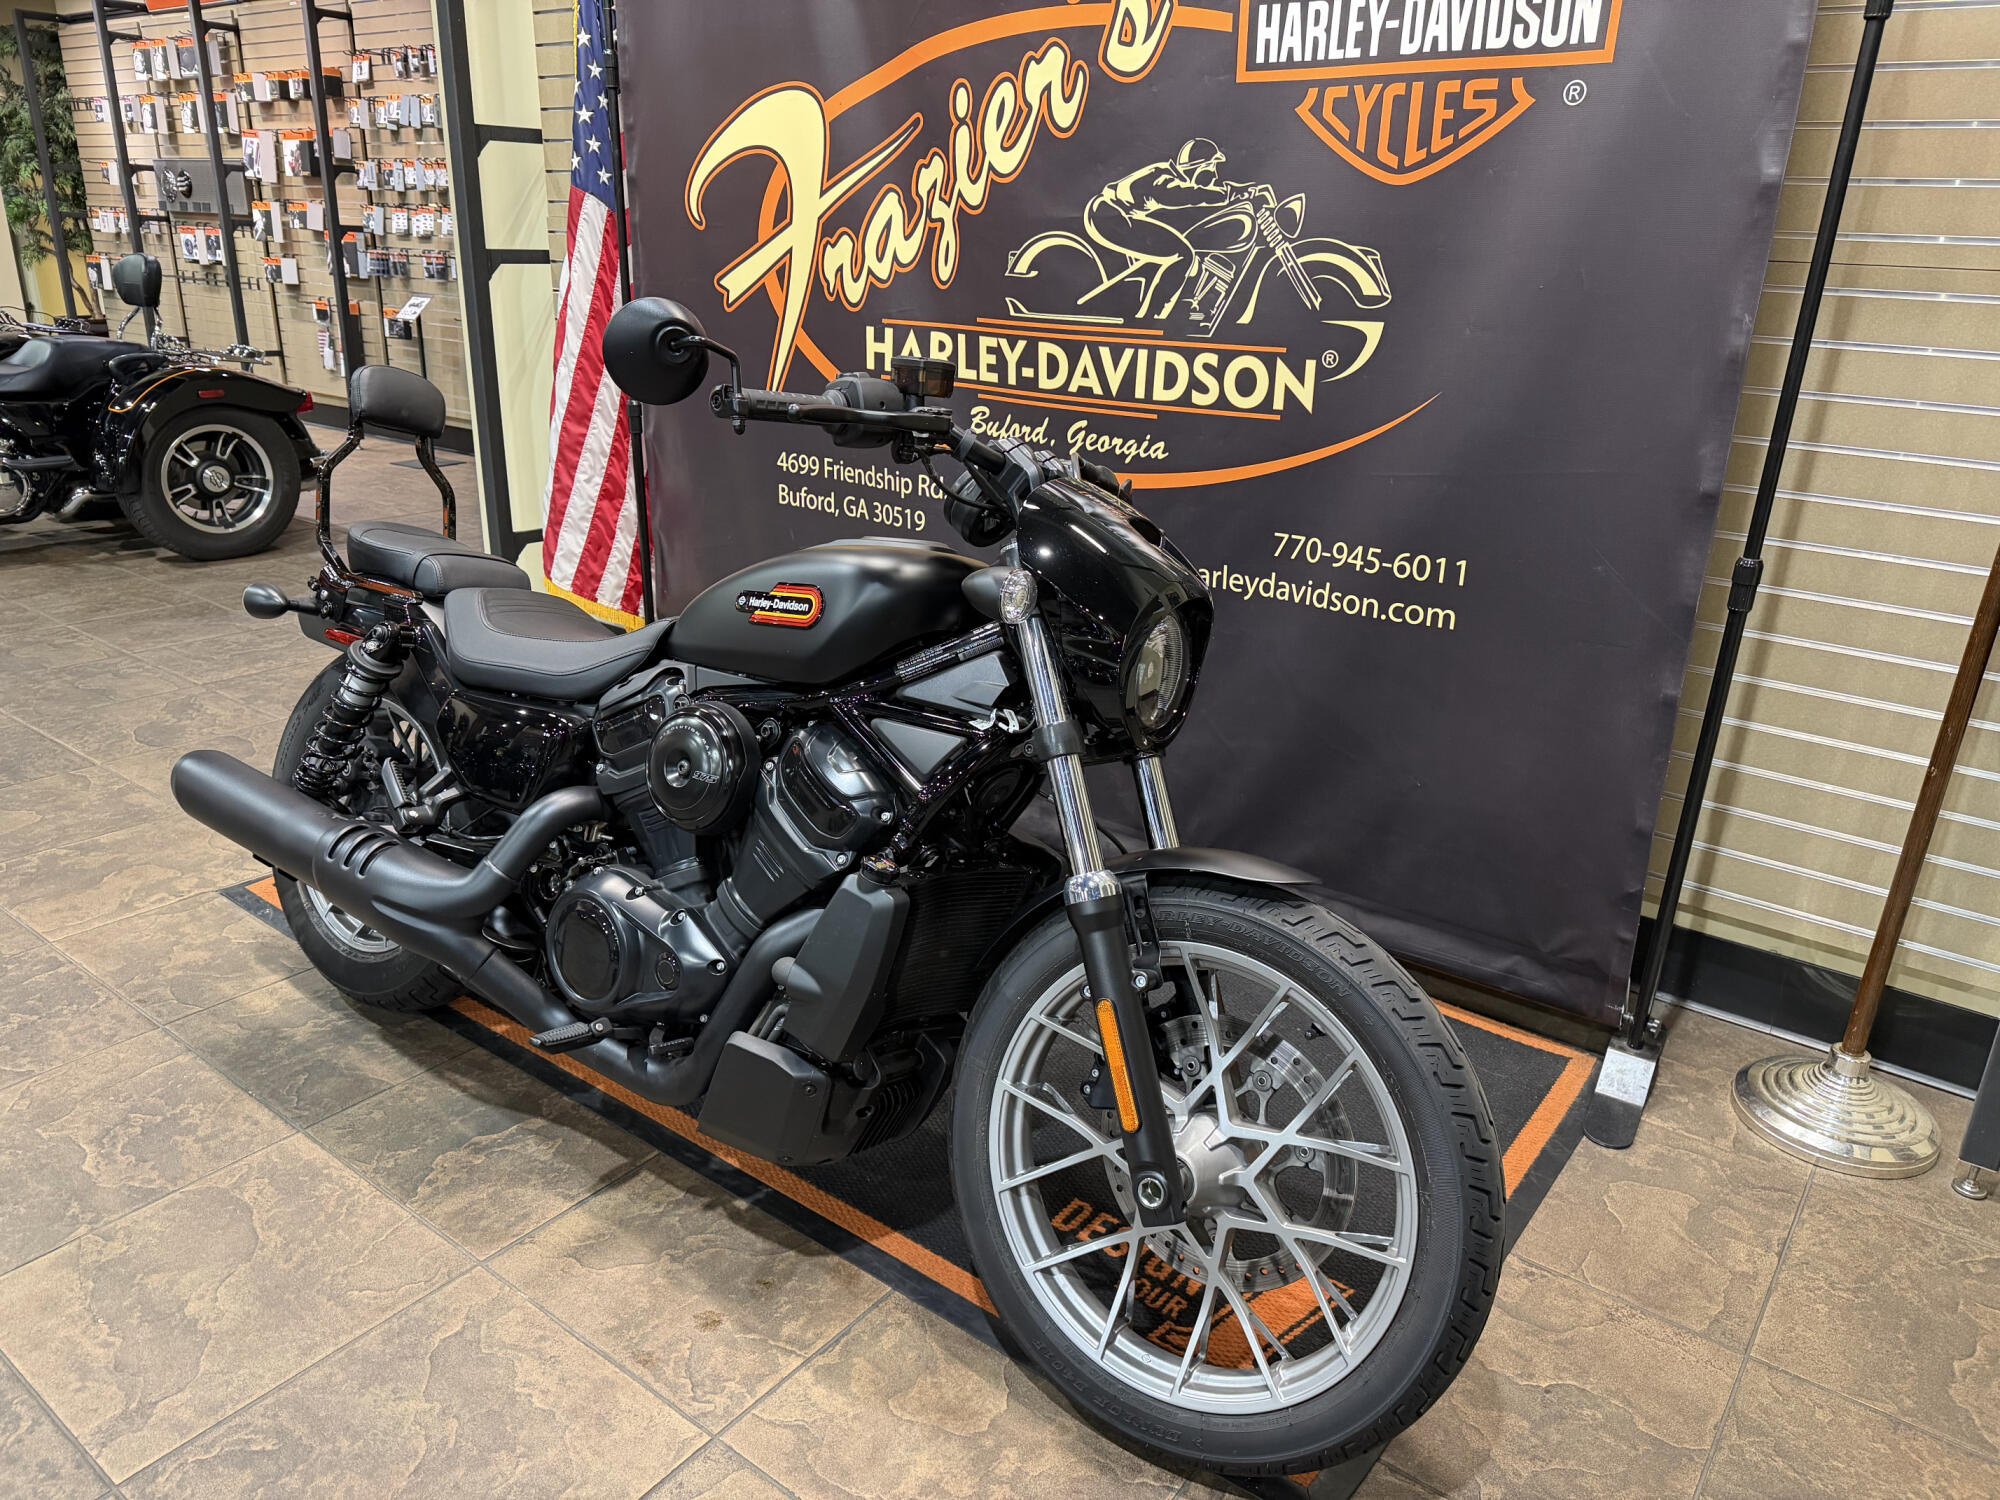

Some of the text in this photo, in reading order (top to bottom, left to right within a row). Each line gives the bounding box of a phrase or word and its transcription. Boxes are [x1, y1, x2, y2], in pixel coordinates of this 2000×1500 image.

[1255, 0, 1603, 63] HARLEY-DAVIDSON
[1322, 78, 1499, 169] CYCLES
[970, 405, 1169, 463] Buford, Georgia
[776, 451, 820, 477] 4699
[823, 457, 913, 499] Friendship
[777, 484, 926, 532] Buford, GA 30519
[1273, 532, 1468, 587] 770-945-6011
[748, 595, 810, 612] Harley-Davidson
[1198, 564, 1457, 630] arleydavidson.com
[692, 770, 720, 784] 975
